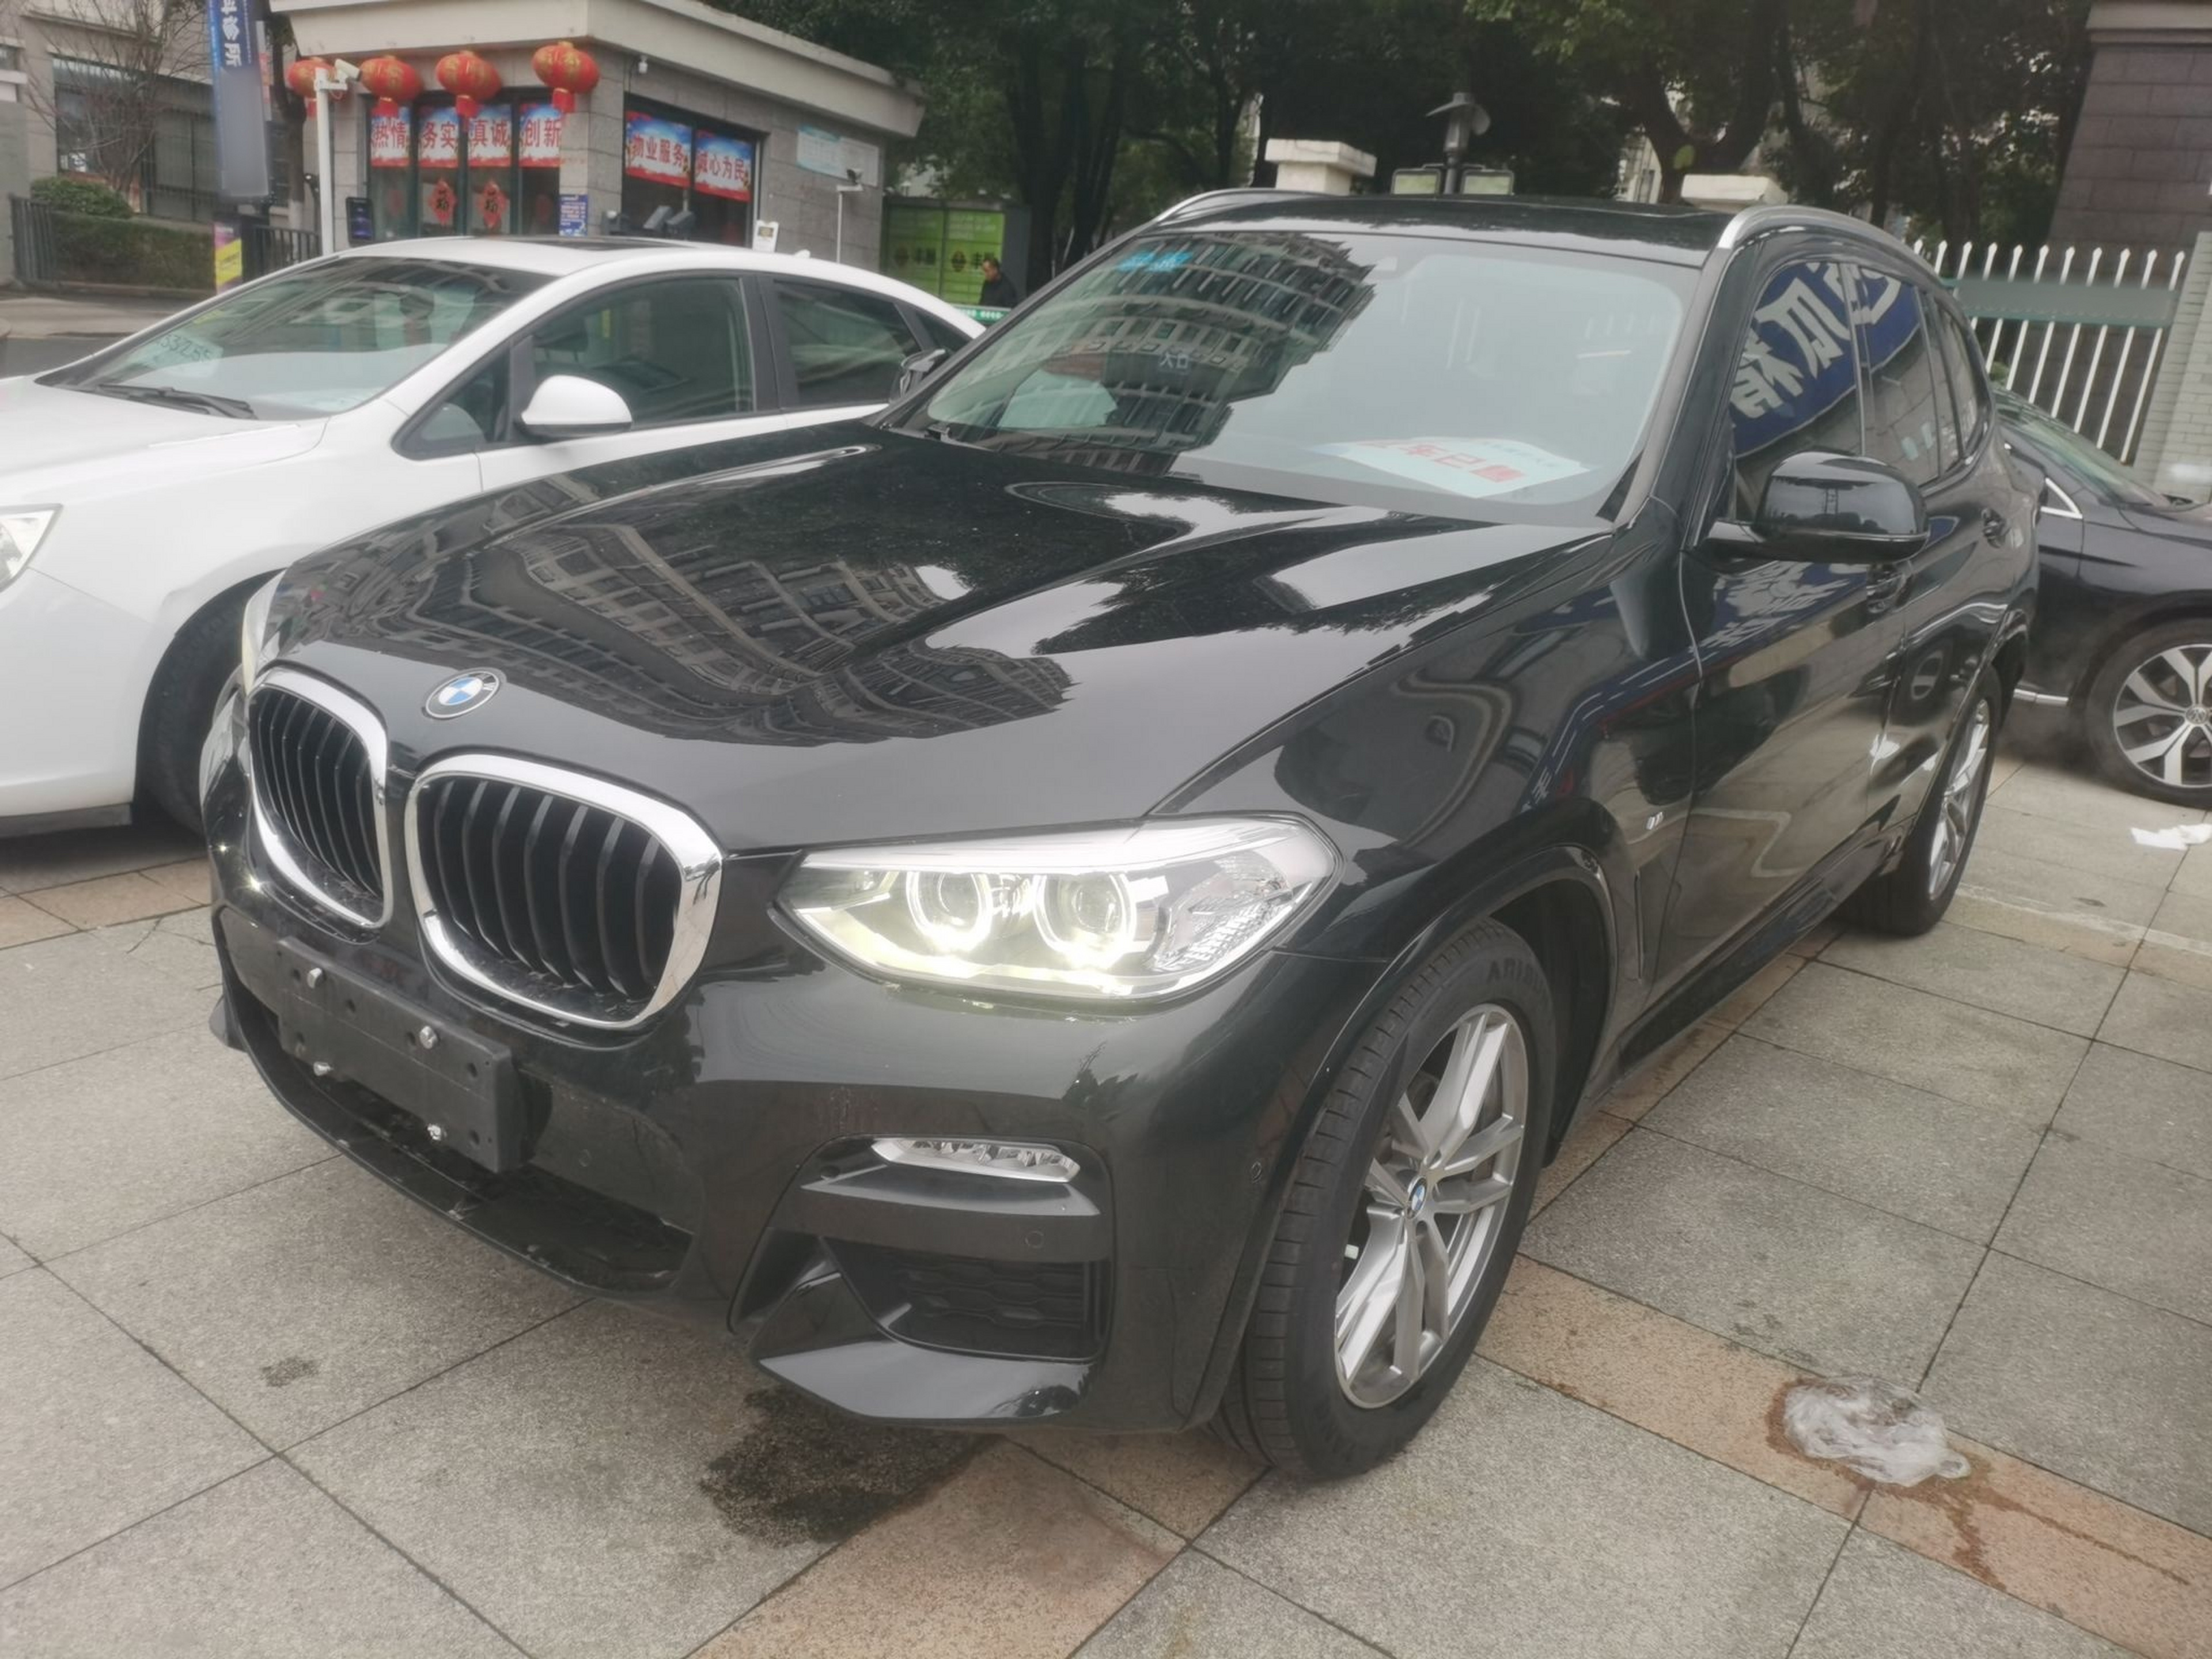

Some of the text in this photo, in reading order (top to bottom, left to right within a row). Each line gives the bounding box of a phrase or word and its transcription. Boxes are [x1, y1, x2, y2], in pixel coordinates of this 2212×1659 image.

[372, 121, 407, 148] 热情
[422, 120, 456, 149] 务实
[471, 118, 509, 147] 真诚
[525, 117, 562, 147] 创新
[632, 132, 684, 167] 物业服务
[696, 149, 745, 181] 诚心为民
